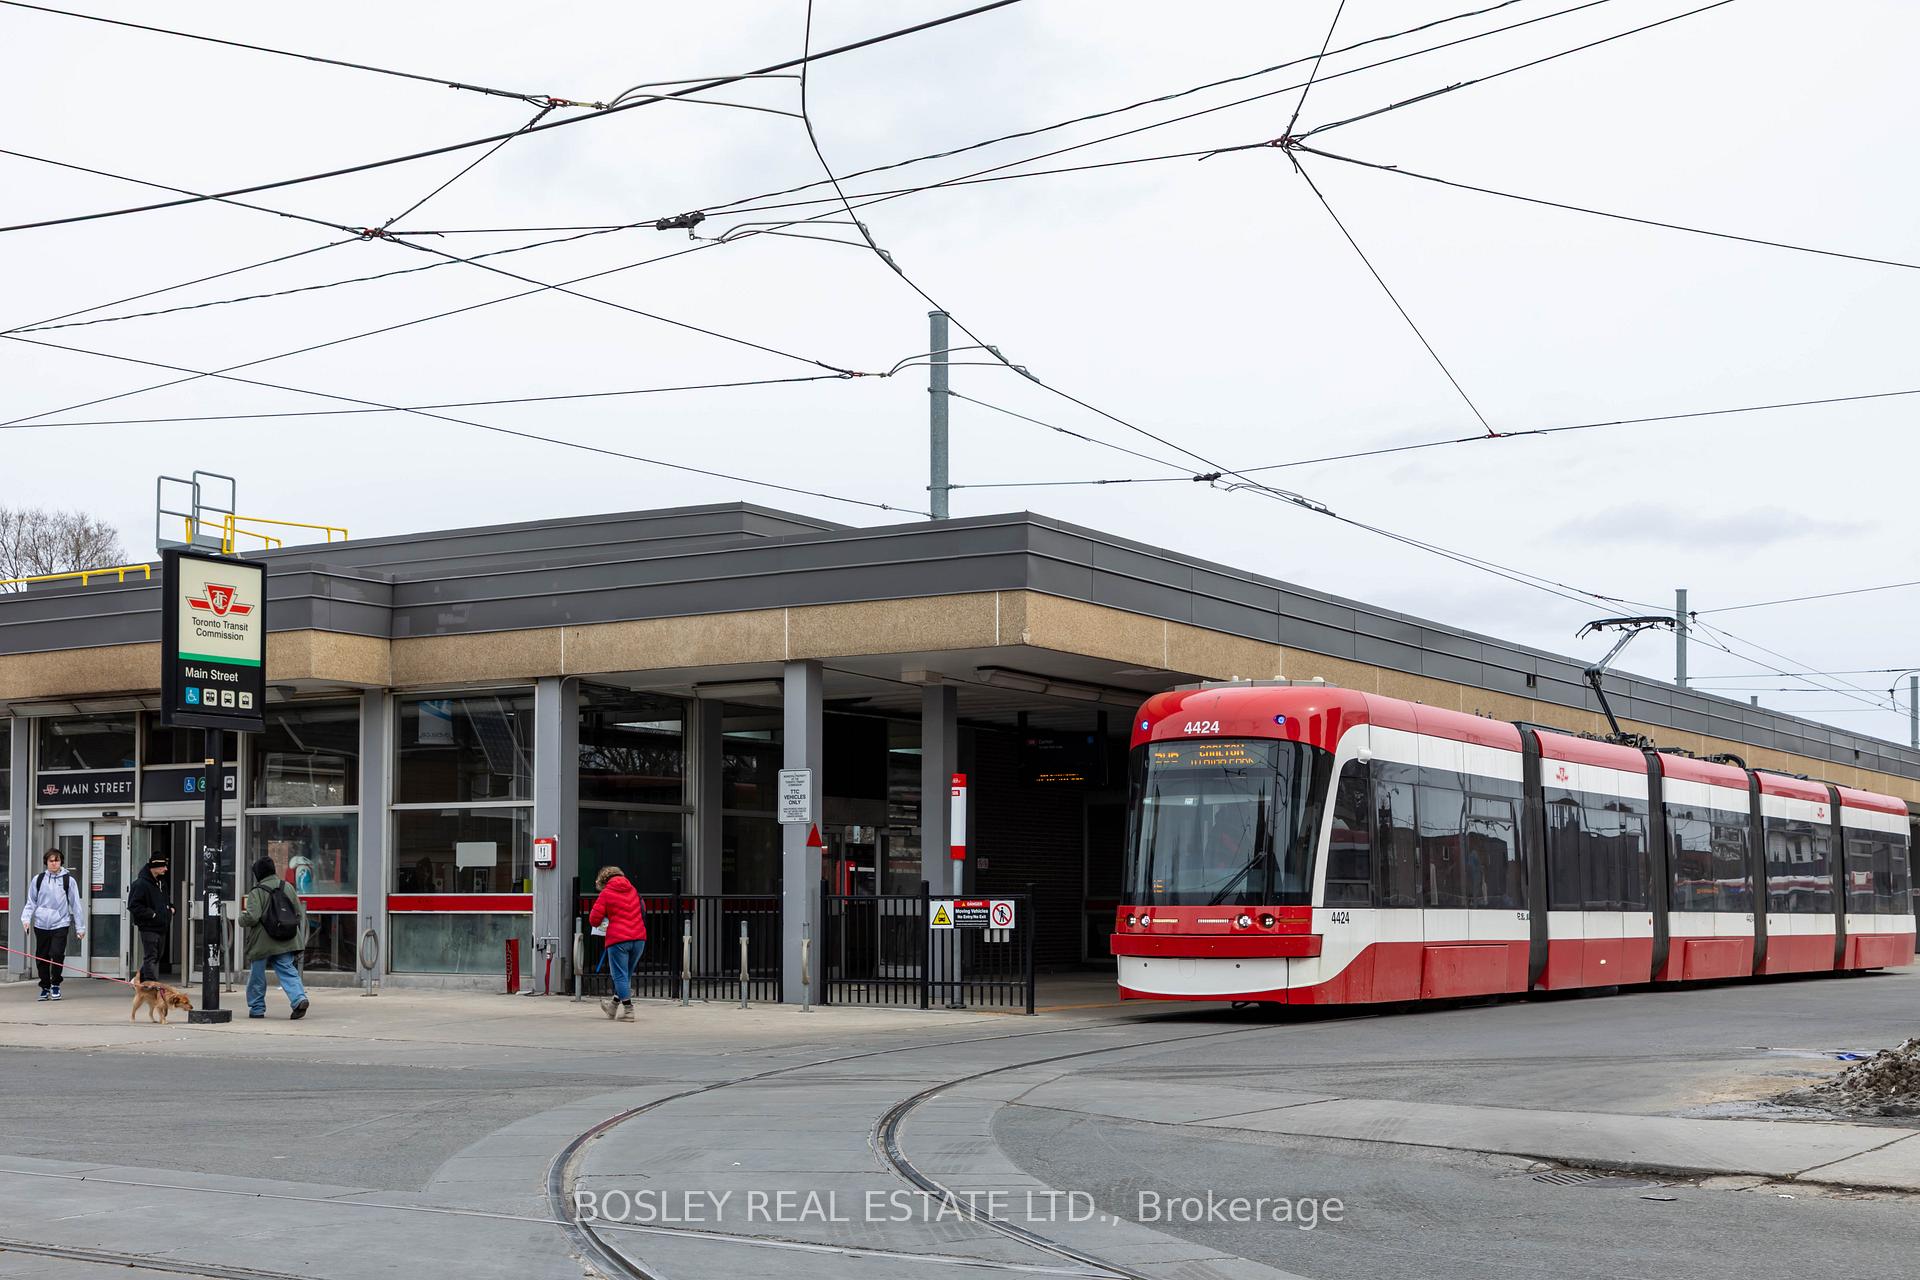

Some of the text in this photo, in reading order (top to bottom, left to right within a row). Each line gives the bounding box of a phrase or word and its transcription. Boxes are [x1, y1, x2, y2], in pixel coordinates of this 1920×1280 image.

[192, 617, 248, 632] Toronto Transit
[196, 628, 244, 641] Commission
[185, 667, 239, 682] Main Street
[1184, 720, 1220, 734] 4424
[62, 781, 132, 795] MAIN STREET
[1331, 911, 1350, 924] 4424
